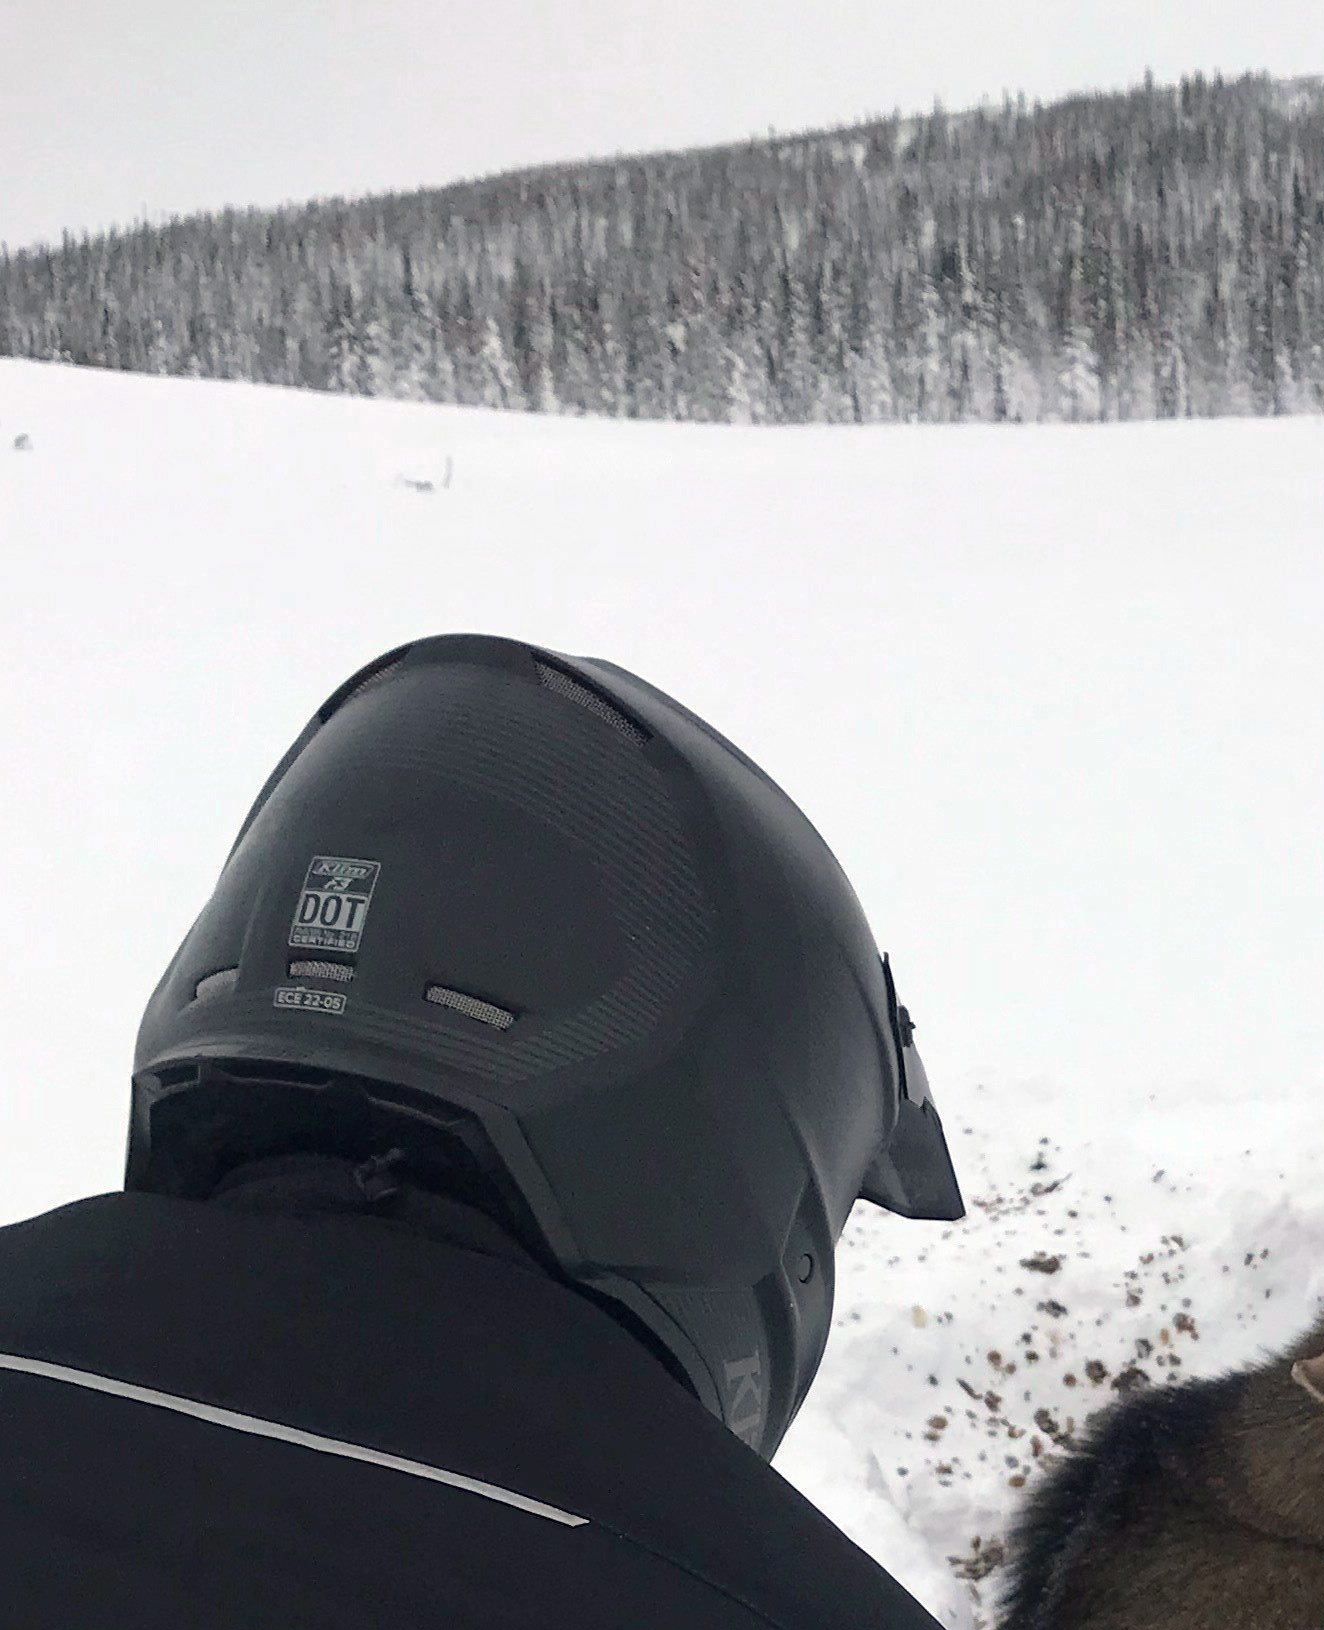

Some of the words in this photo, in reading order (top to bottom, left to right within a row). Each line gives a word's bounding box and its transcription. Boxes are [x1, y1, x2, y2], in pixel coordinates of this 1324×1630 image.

[298, 893, 366, 928] DOT
[293, 935, 355, 949] CERTIFIED
[278, 991, 302, 1004] ECE
[303, 993, 341, 1009] 22-05
